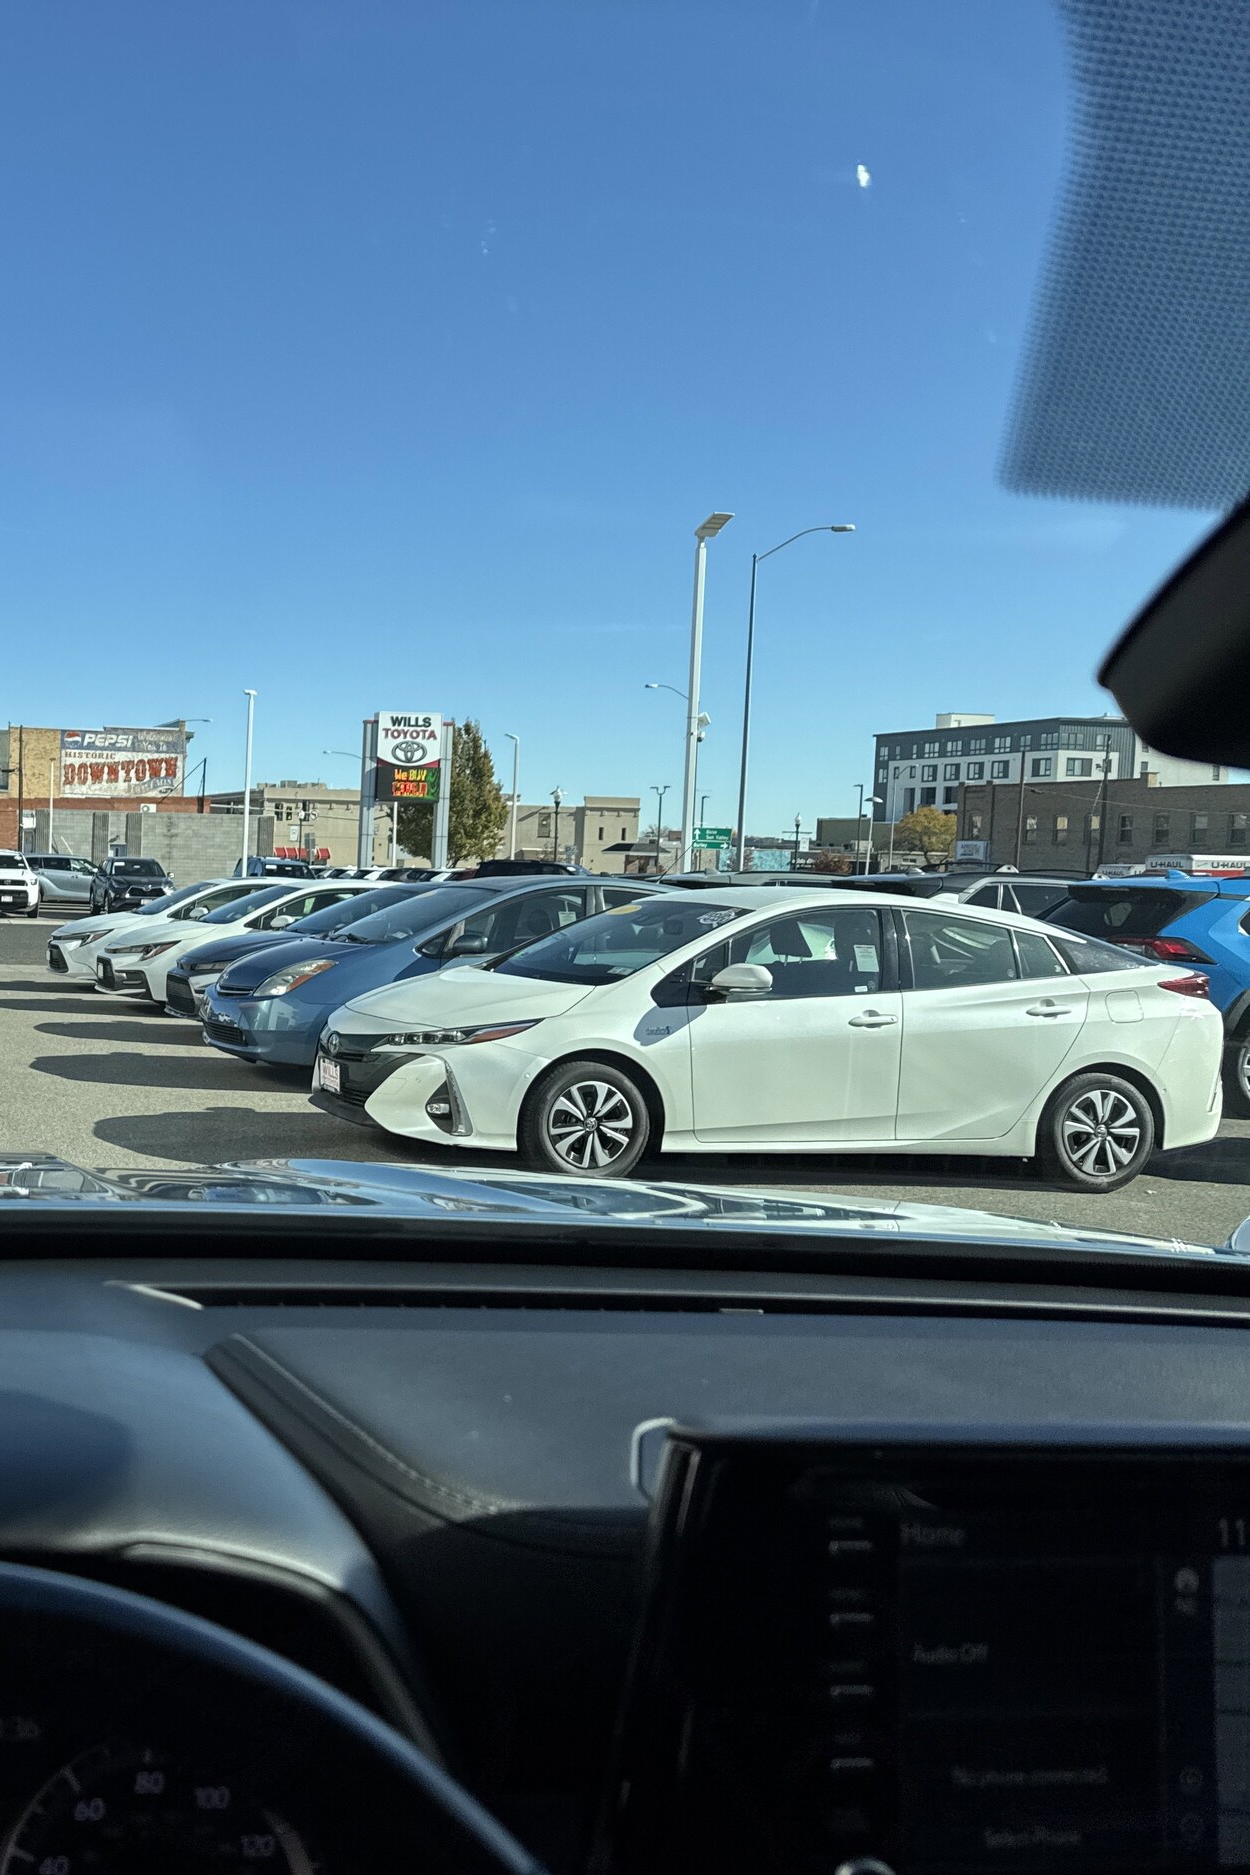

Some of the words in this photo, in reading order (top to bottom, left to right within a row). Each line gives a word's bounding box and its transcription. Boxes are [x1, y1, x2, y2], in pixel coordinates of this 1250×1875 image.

[390, 716, 432, 728] WILLS
[83, 733, 133, 747] PEPSI
[382, 728, 437, 740] TOYOTA
[64, 751, 117, 760] HISTORIC
[63, 757, 179, 786] DOWNTOWN
[134, 1770, 167, 1796] 80
[193, 1785, 232, 1810] 100
[73, 1796, 107, 1823] 60
[239, 1833, 277, 1859] 120
[38, 1853, 71, 1875] 40
